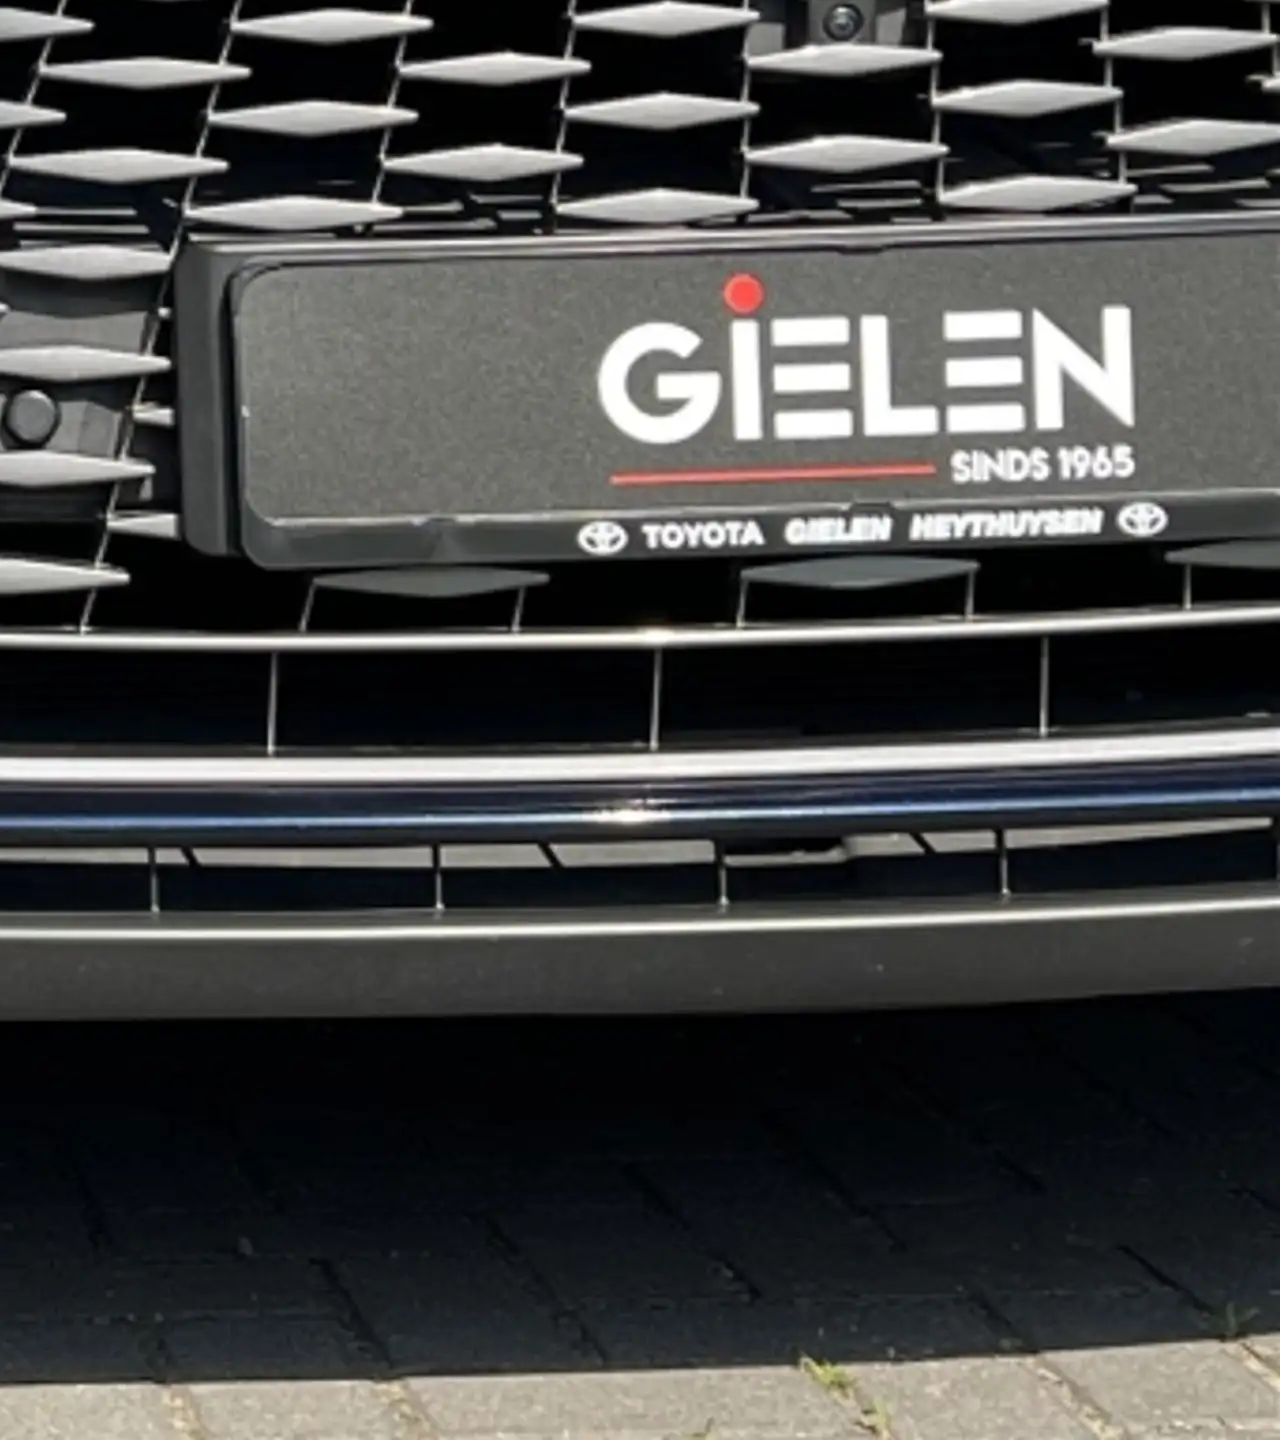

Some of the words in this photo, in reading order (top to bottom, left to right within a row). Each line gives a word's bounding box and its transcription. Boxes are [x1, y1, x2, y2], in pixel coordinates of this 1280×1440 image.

[950, 448, 1051, 485] SINDS
[1057, 444, 1136, 479] 1965
[642, 520, 765, 548] TOYOTA
[784, 515, 893, 546] GIELEN
[909, 508, 1105, 541] HEYTHUYSEN
